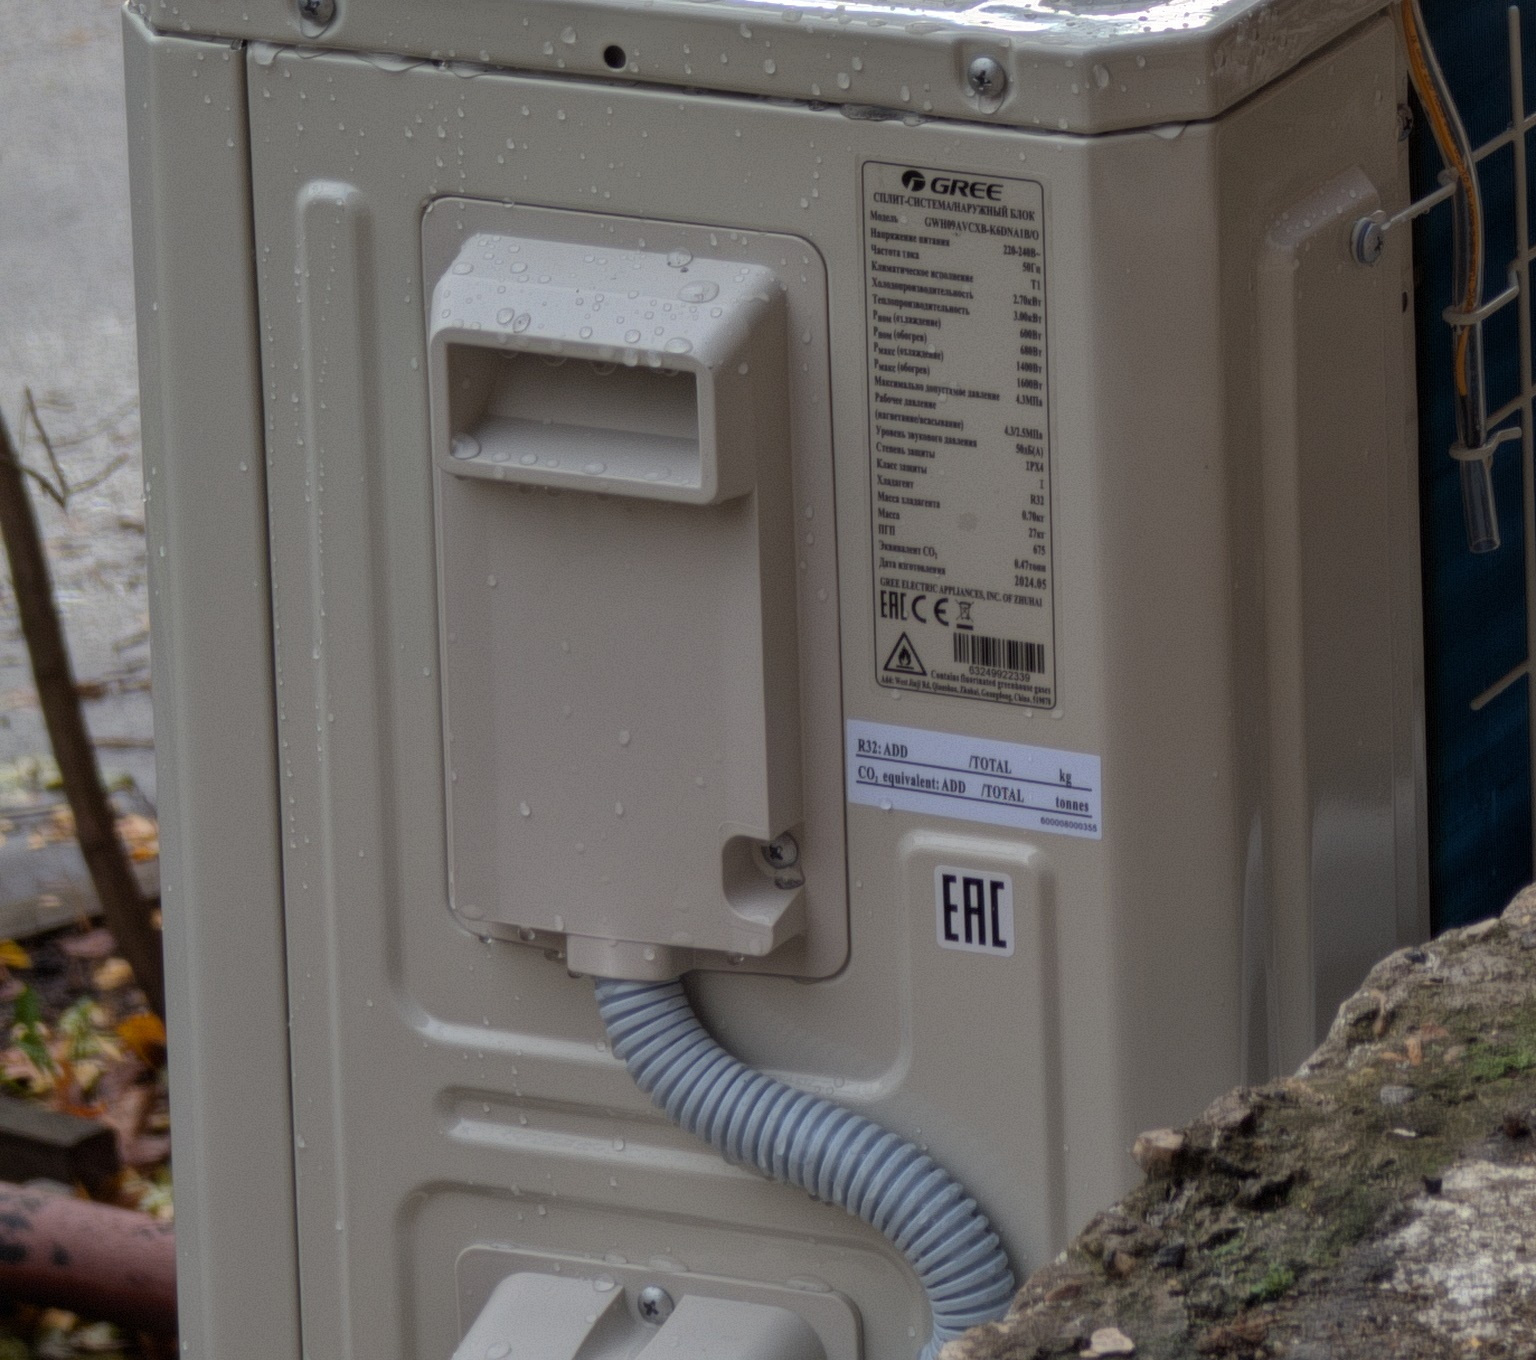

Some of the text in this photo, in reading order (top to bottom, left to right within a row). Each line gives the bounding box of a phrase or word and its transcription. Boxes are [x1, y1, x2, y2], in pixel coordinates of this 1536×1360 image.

[931, 176, 1004, 202] GREE
[870, 210, 898, 223] Модель
[873, 191, 1035, 221] СПЛИТ-СИСТЕМА/НАРУЖНЫЙ БЛОК
[870, 228, 917, 245] Напряжение
[871, 245, 900, 257] Частота
[871, 261, 929, 277] Климатическое
[874, 376, 924, 392] Максимально
[876, 428, 905, 440] Уровень
[876, 442, 905, 455] Степень
[907, 448, 935, 459] защиты
[877, 458, 897, 470] Класс
[900, 464, 927, 474] защиты
[877, 475, 1044, 506] Хладагент R32
[877, 491, 899, 504] Масса
[878, 508, 1044, 539] Масса 27кг
[878, 524, 1046, 556] ПГП 675
[879, 558, 896, 570] Дата
[1015, 575, 1047, 590] 2024.05
[880, 577, 1042, 608] GREE ELECTRIC APPLIANCES, INC. OF ZHUHAI
[881, 590, 907, 621] EAC
[931, 670, 959, 682] Contains
[969, 666, 1030, 682] 63249922339
[858, 738, 1072, 786] R32: ADD /TOTAL kg
[883, 772, 940, 790] equivalent:
[942, 778, 966, 794] ADD
[981, 783, 1024, 803] /TOTAL
[1055, 796, 1089, 812] tonnes
[942, 874, 1007, 949] EAC
